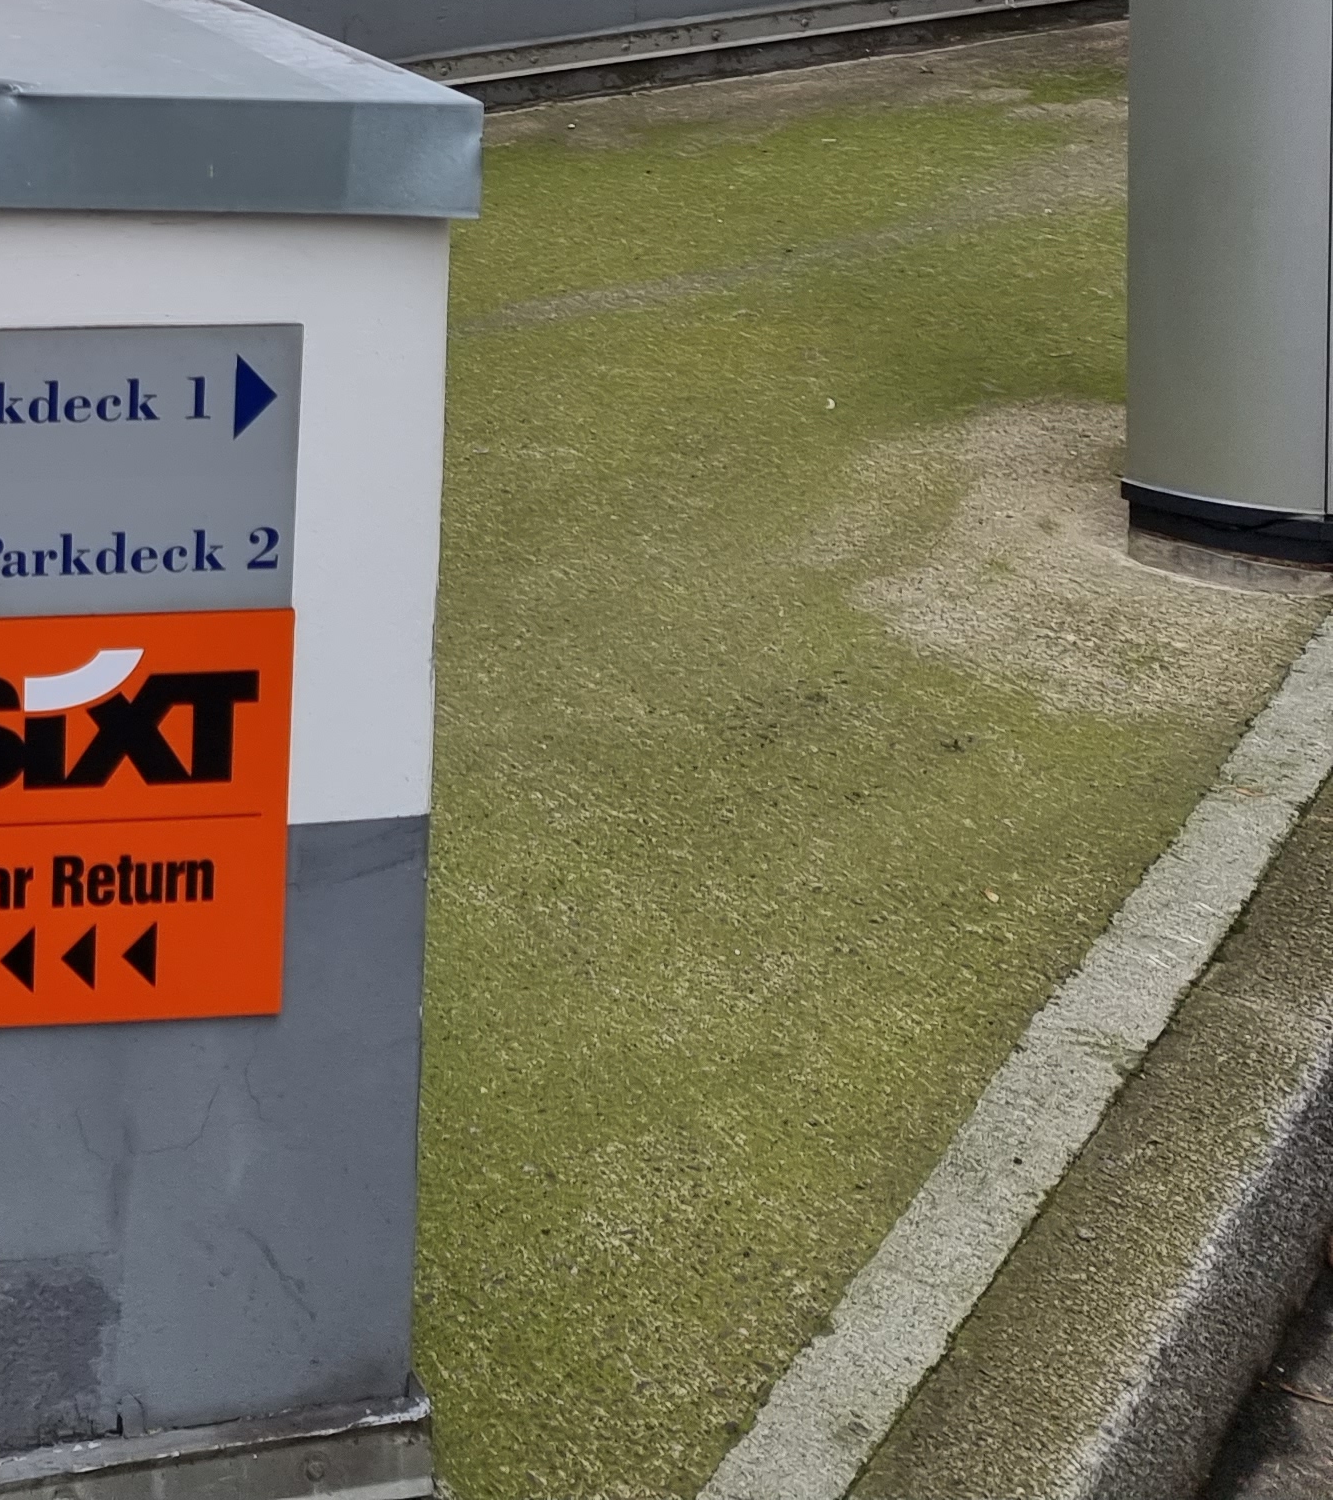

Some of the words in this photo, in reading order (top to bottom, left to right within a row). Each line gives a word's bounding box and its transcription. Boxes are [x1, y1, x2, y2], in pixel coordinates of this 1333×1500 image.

[185, 375, 212, 420] 1
[247, 526, 280, 570] 2
[51, 854, 215, 908] Return
